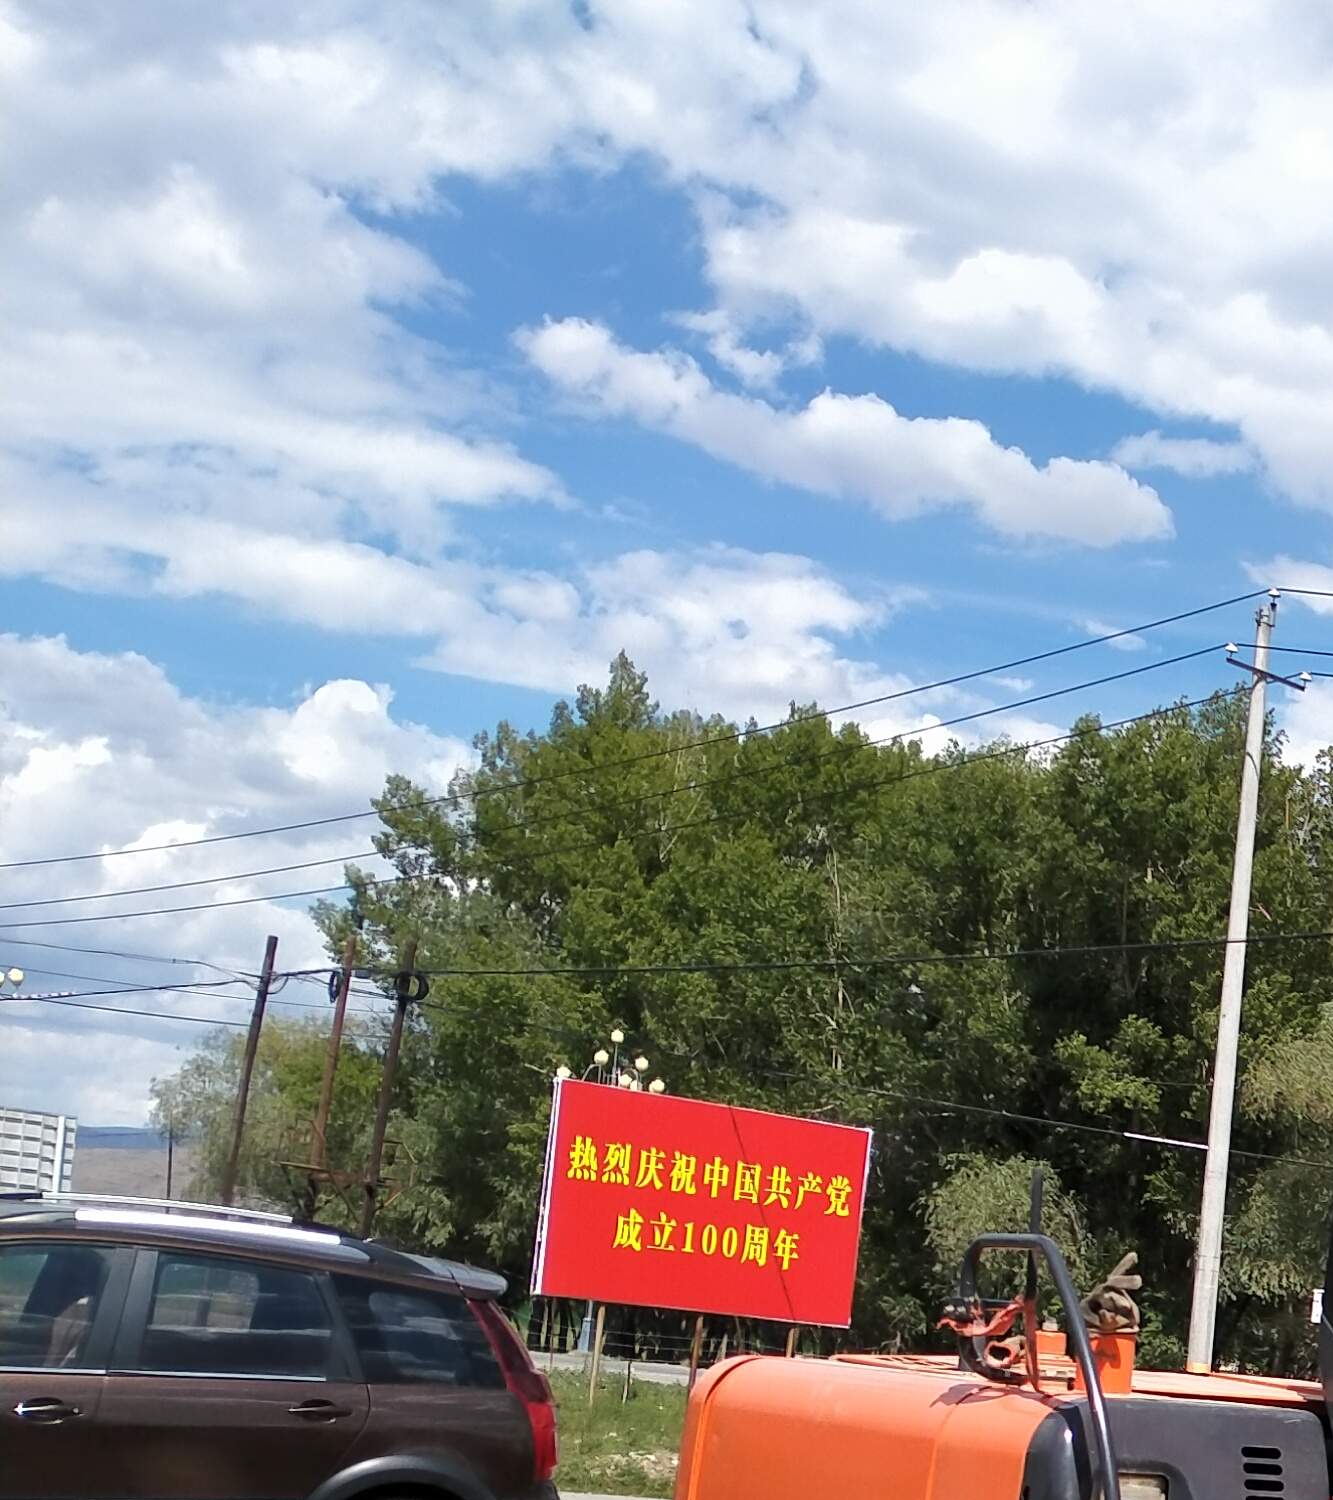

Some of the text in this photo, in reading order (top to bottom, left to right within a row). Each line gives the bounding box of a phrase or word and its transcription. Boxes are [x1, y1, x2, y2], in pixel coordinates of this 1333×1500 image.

[567, 1135, 853, 1217] 热烈庆祝中国共产党
[612, 1208, 801, 1271] 成立100周年
